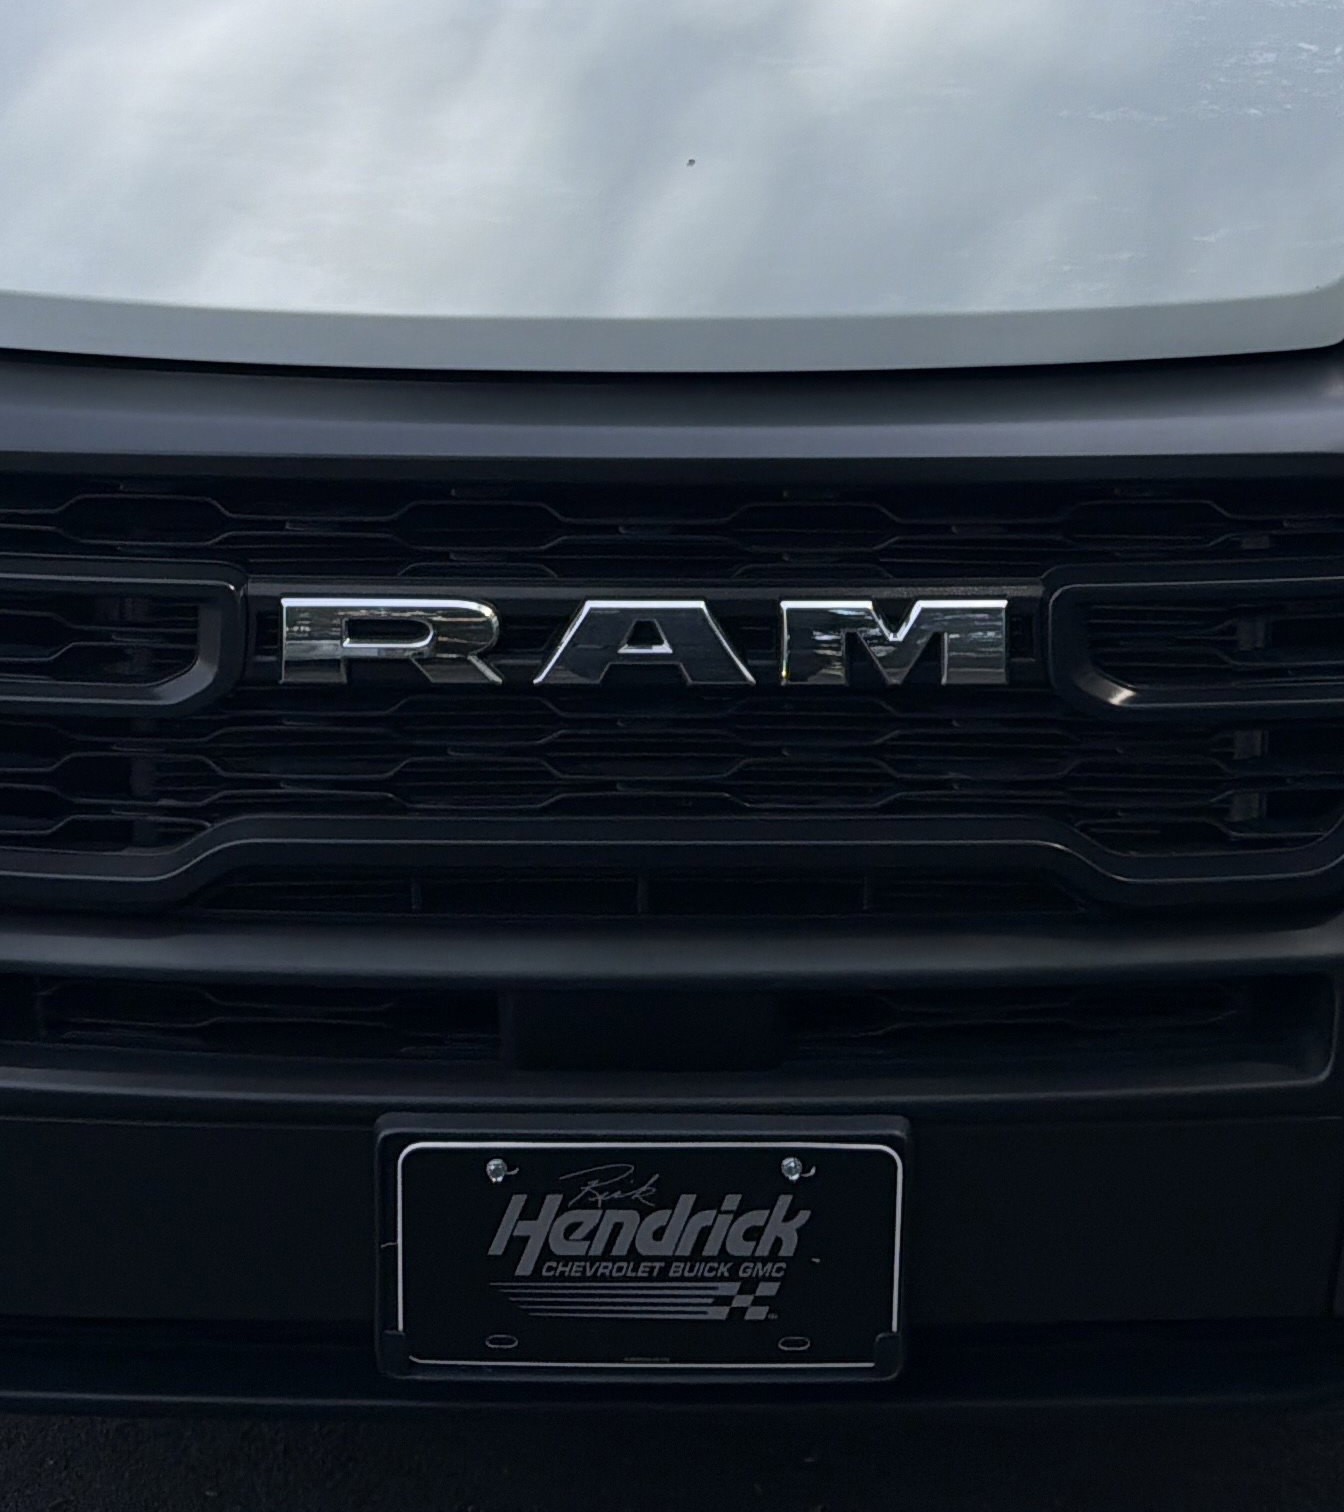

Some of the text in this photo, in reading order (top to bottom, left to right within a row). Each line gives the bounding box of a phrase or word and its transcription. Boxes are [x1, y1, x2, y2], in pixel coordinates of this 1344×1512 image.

[281, 597, 1008, 685] RAM
[487, 1194, 810, 1276] Hendrick
[541, 1262, 786, 1277] CHEVROLET BUICK GMC
